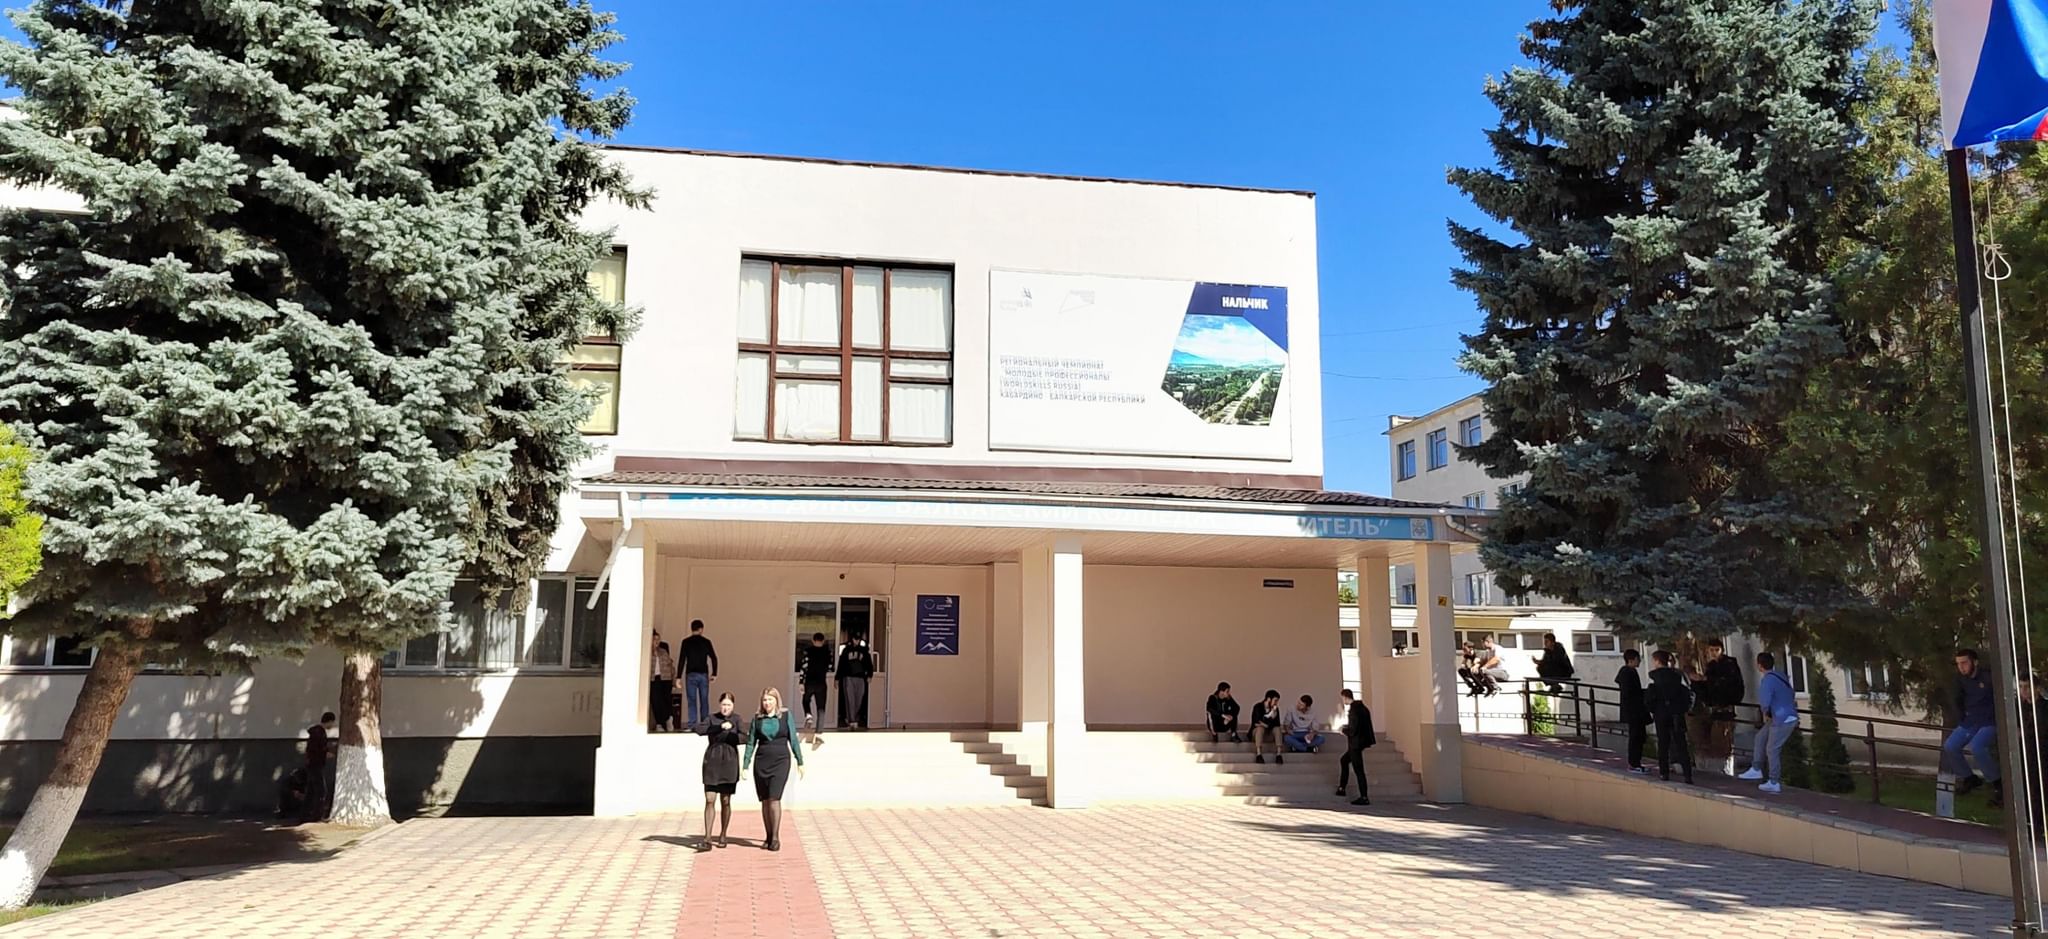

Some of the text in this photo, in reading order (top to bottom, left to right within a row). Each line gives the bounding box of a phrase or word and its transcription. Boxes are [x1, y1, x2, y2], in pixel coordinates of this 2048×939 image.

[1222, 296, 1268, 309] НАЛЬЧИК
[1000, 357, 1104, 370] РЕГИОНАЛЬНЫЙ ЧЕМПИОНАТ
